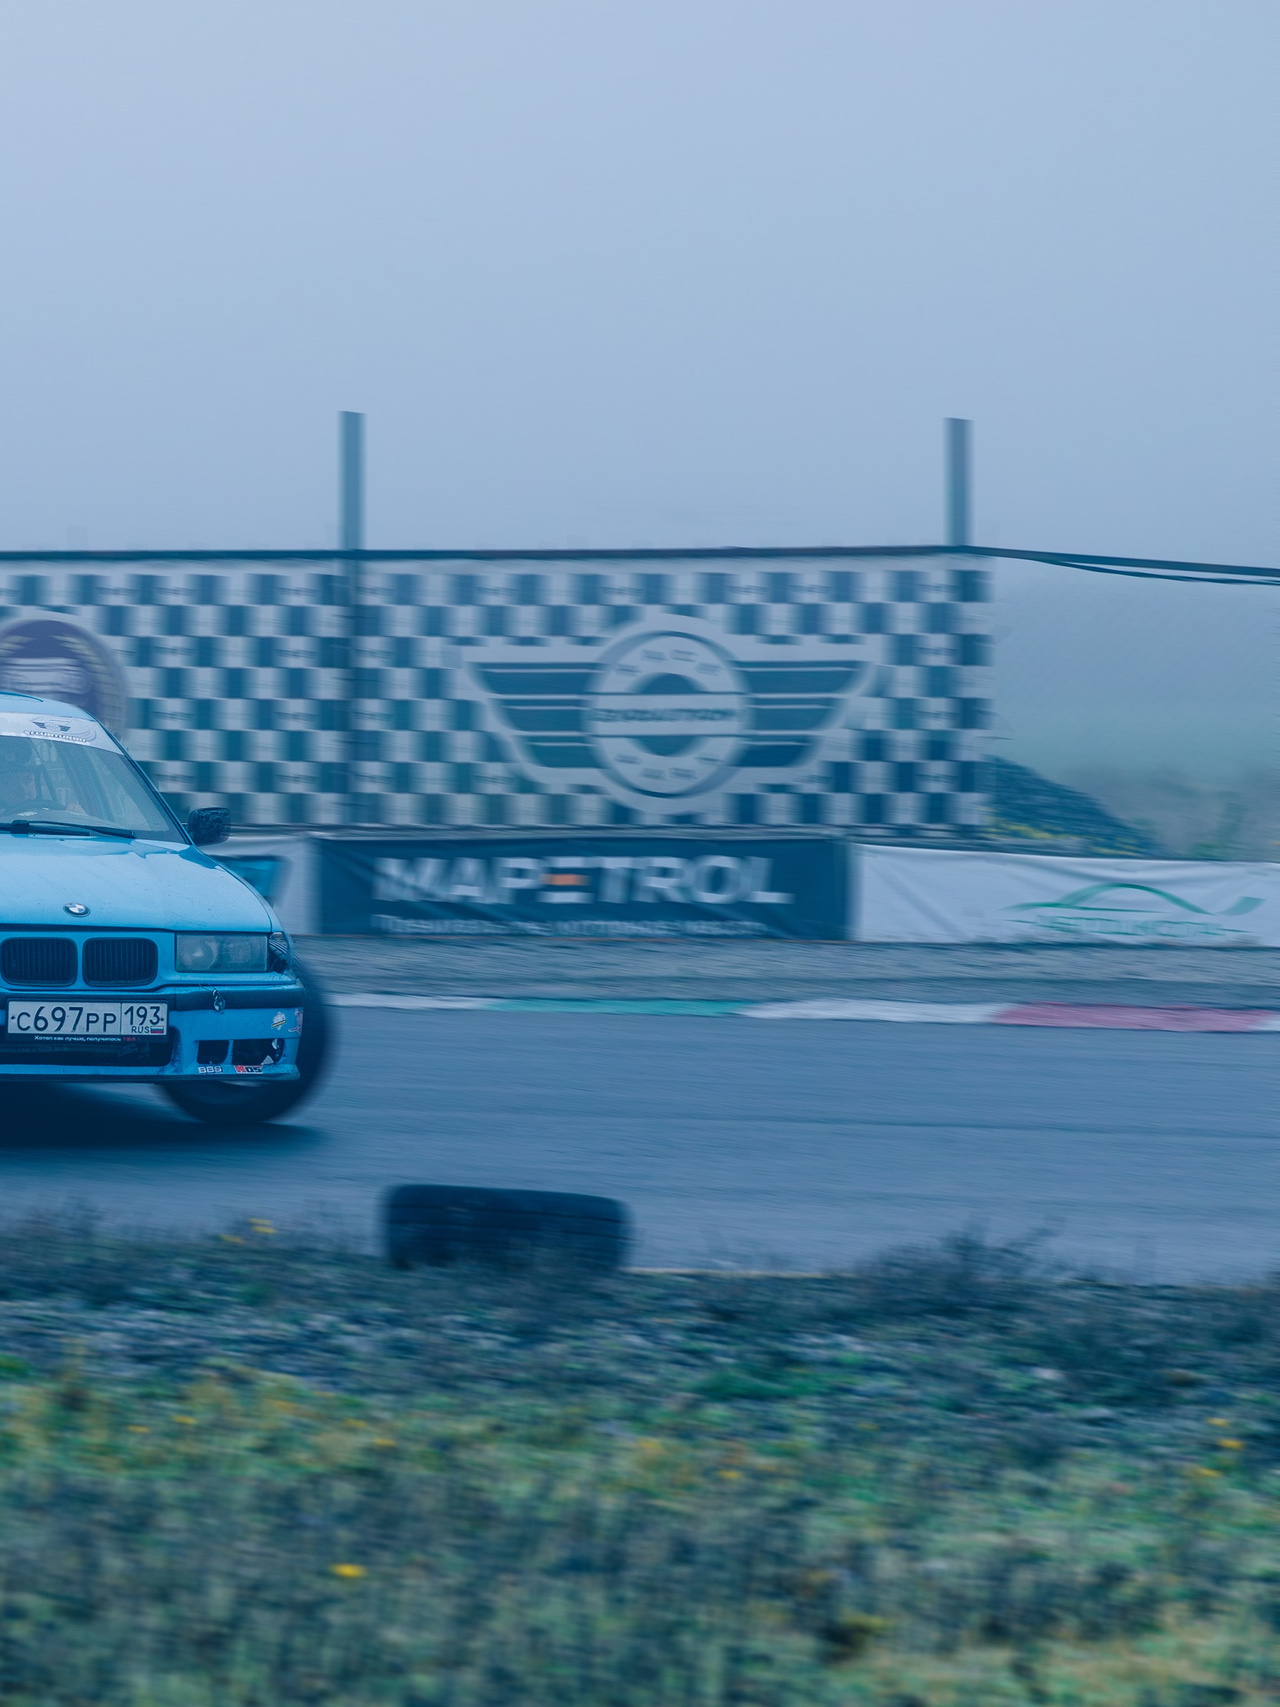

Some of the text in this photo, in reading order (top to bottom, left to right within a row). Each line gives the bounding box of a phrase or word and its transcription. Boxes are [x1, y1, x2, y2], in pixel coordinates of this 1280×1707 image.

[373, 855, 795, 904] MAPETROL
[123, 1005, 161, 1026] 193
[131, 1026, 150, 1034] RUS
[198, 1066, 223, 1074] BBS
[234, 1065, 263, 1074] NOS
